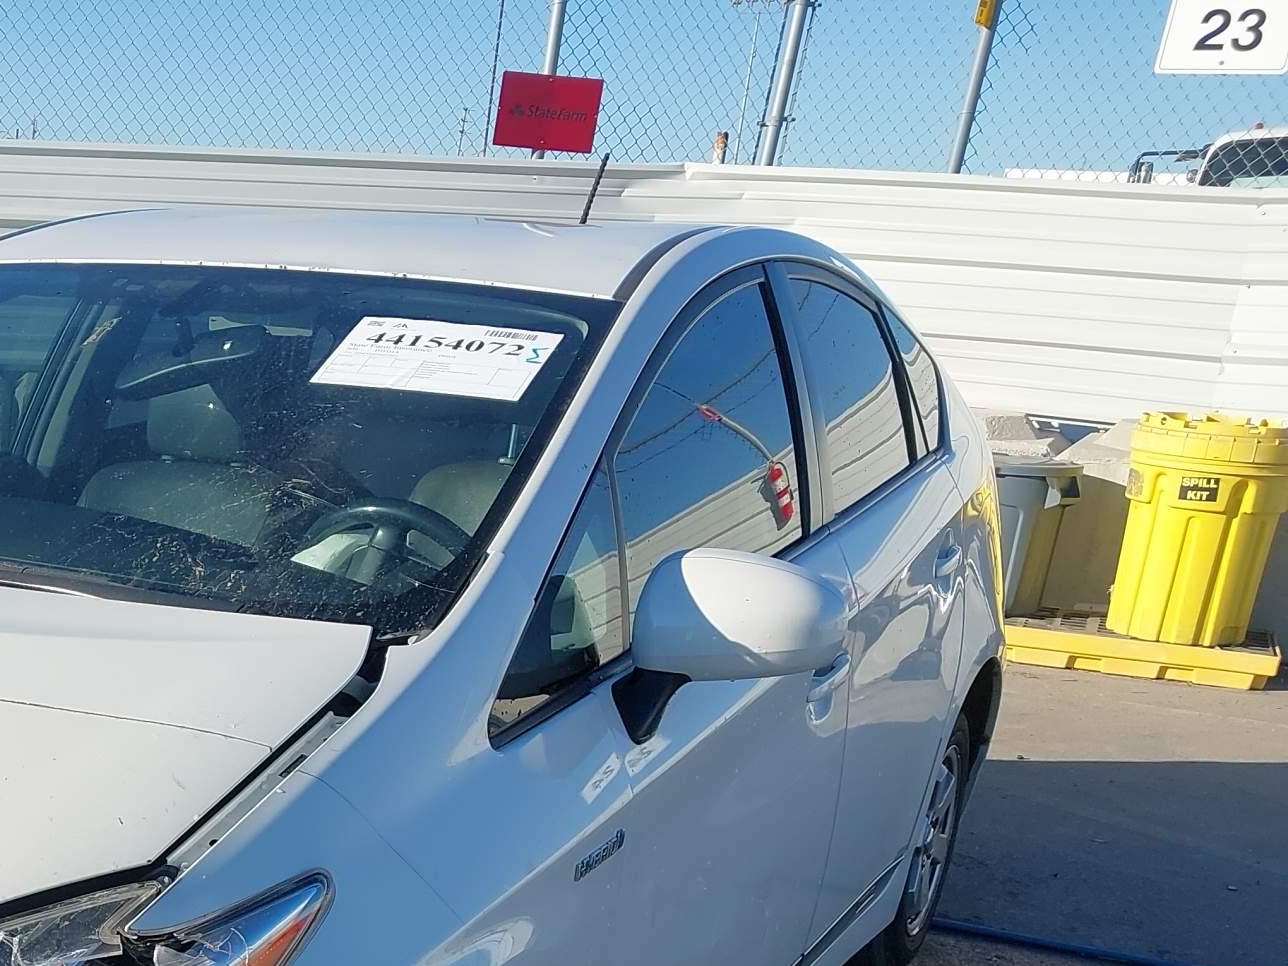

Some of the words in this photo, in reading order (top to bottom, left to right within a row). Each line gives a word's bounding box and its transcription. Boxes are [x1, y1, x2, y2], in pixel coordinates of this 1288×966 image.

[1192, 8, 1267, 51] 23
[365, 332, 525, 356] 44154072
[1182, 477, 1218, 488] SPILL
[1186, 490, 1210, 501] KIT
